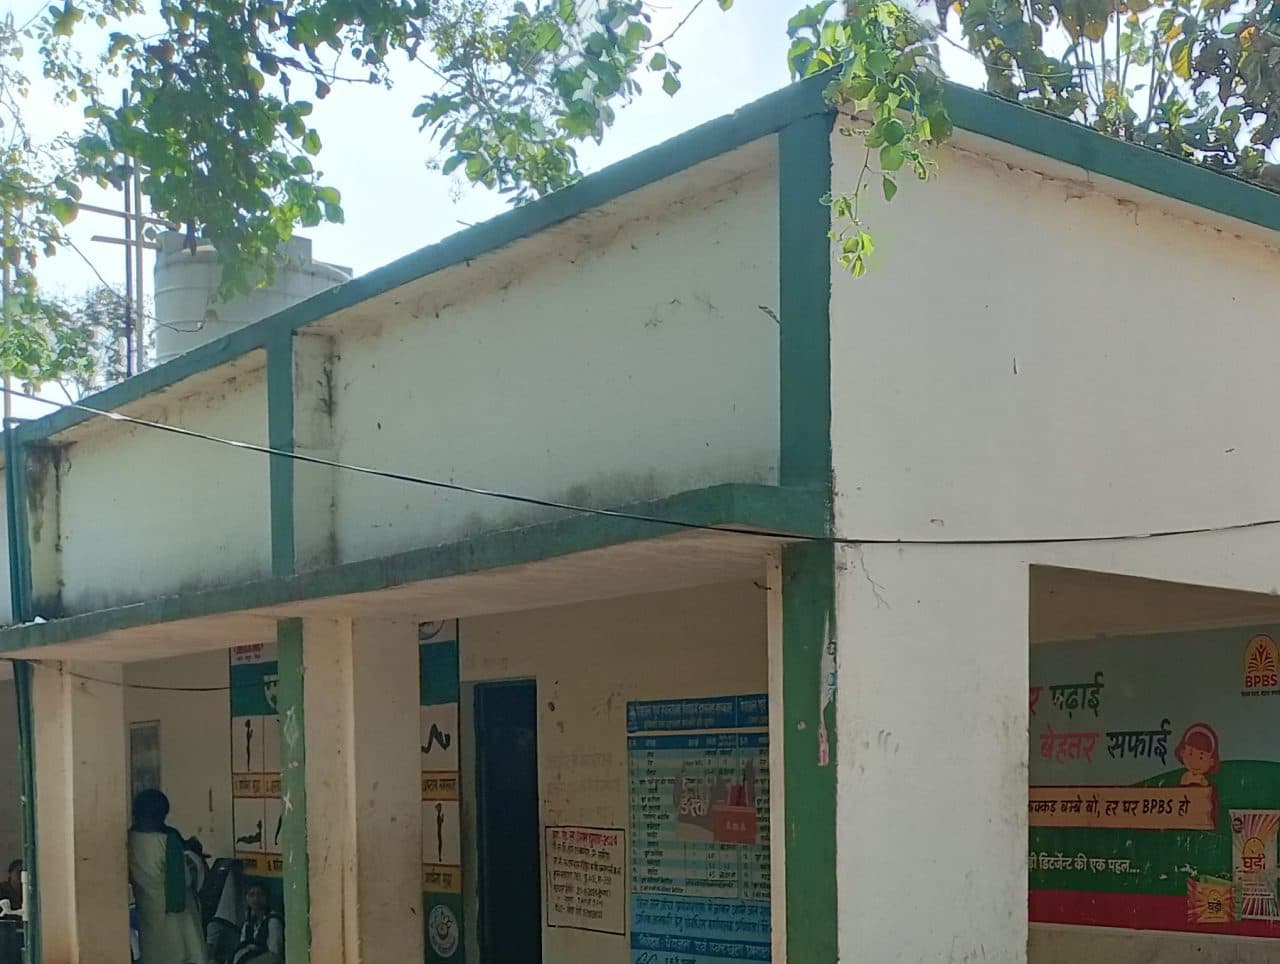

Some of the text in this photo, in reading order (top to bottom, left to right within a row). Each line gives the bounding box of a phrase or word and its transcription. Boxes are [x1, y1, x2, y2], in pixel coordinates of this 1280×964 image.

[1245, 674, 1277, 688] BPBS
[1049, 672, 1104, 718] पढ़ाई
[1040, 718, 1172, 765] बेहतर सफाई
[1106, 800, 1119, 816] हर
[1122, 800, 1140, 816] घर
[1143, 799, 1173, 815] BPBS
[1178, 795, 1192, 816] हो
[1074, 853, 1087, 871] की
[1090, 858, 1105, 874] एक
